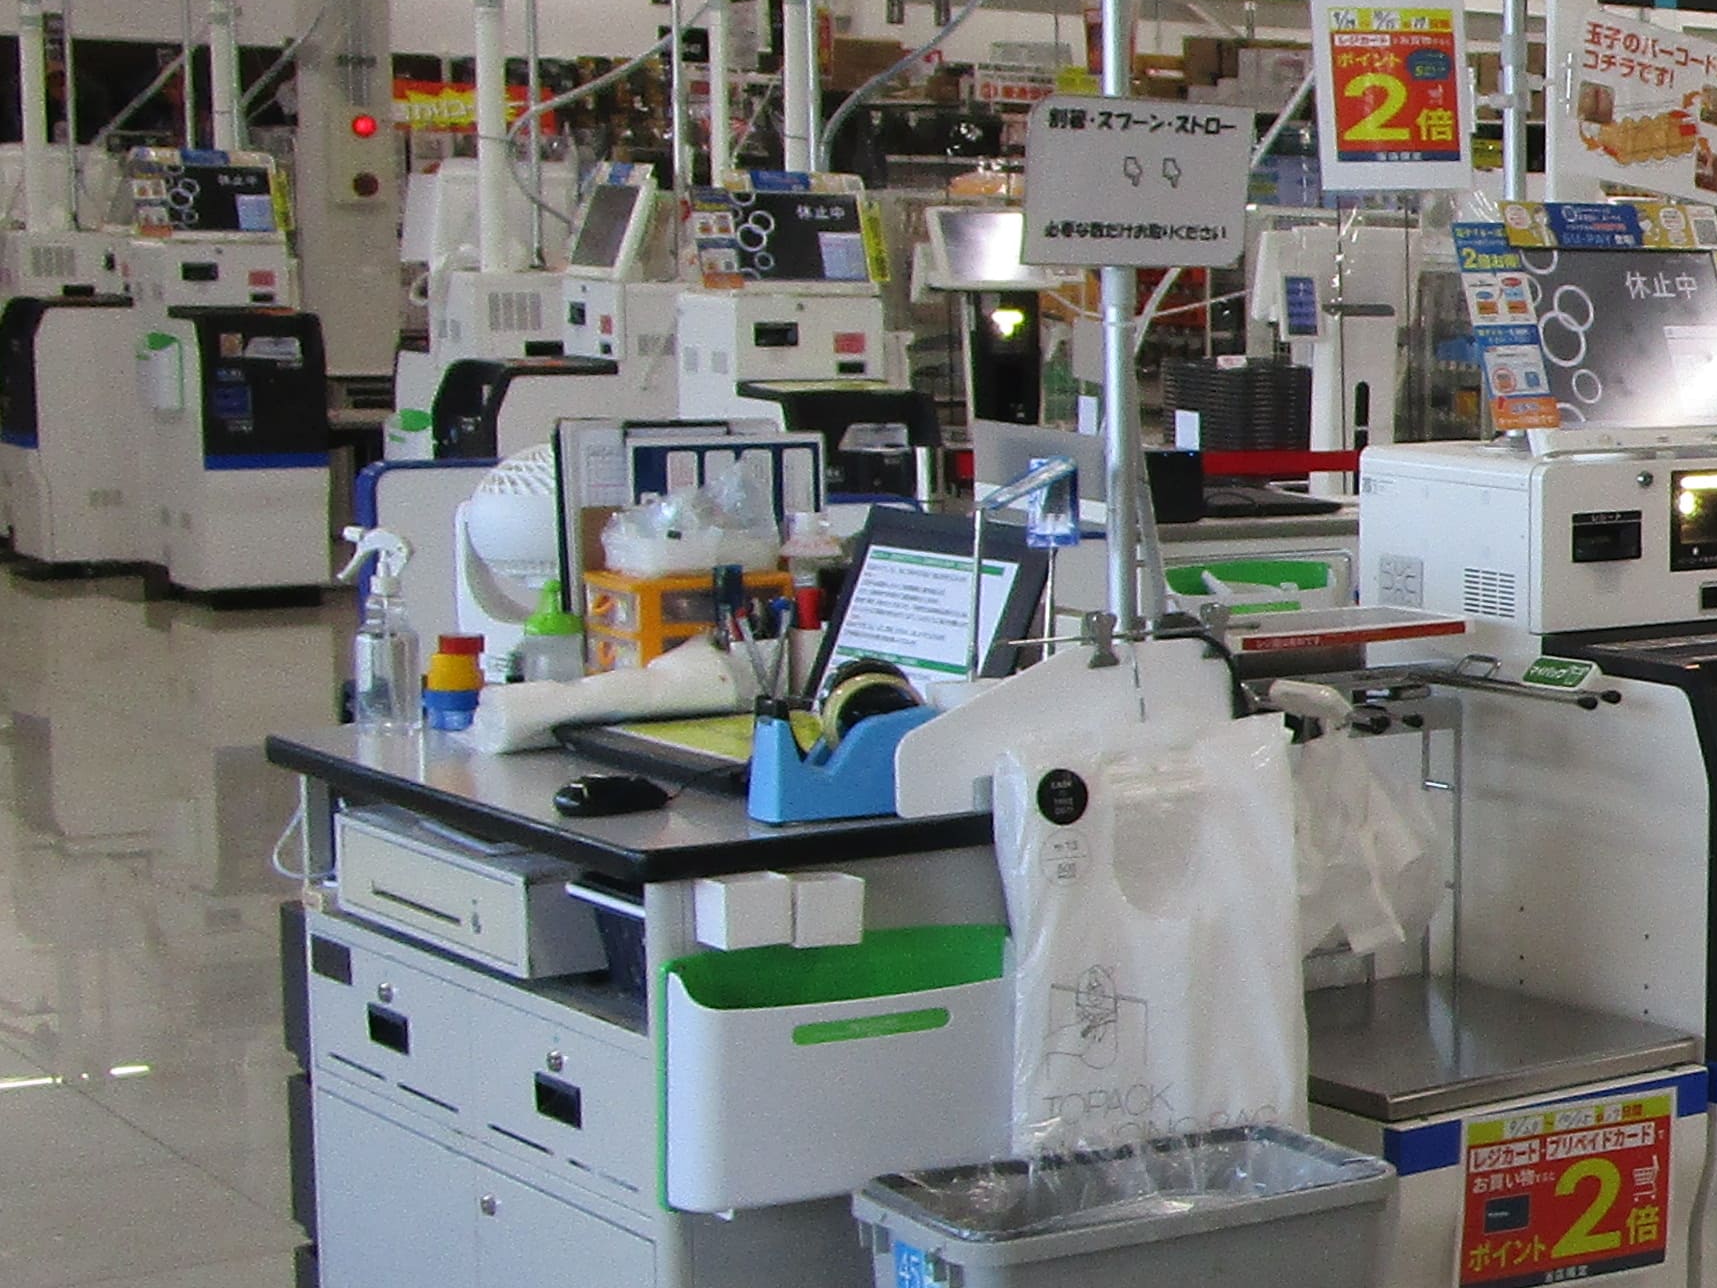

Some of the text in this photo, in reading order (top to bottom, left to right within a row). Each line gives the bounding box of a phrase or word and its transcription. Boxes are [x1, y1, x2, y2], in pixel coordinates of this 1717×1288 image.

[1338, 52, 1401, 68] ポイント
[1583, 48, 1675, 89] コチラです!
[1625, 271, 1698, 300] 休止中
[1469, 1234, 1548, 1272] ポイント
